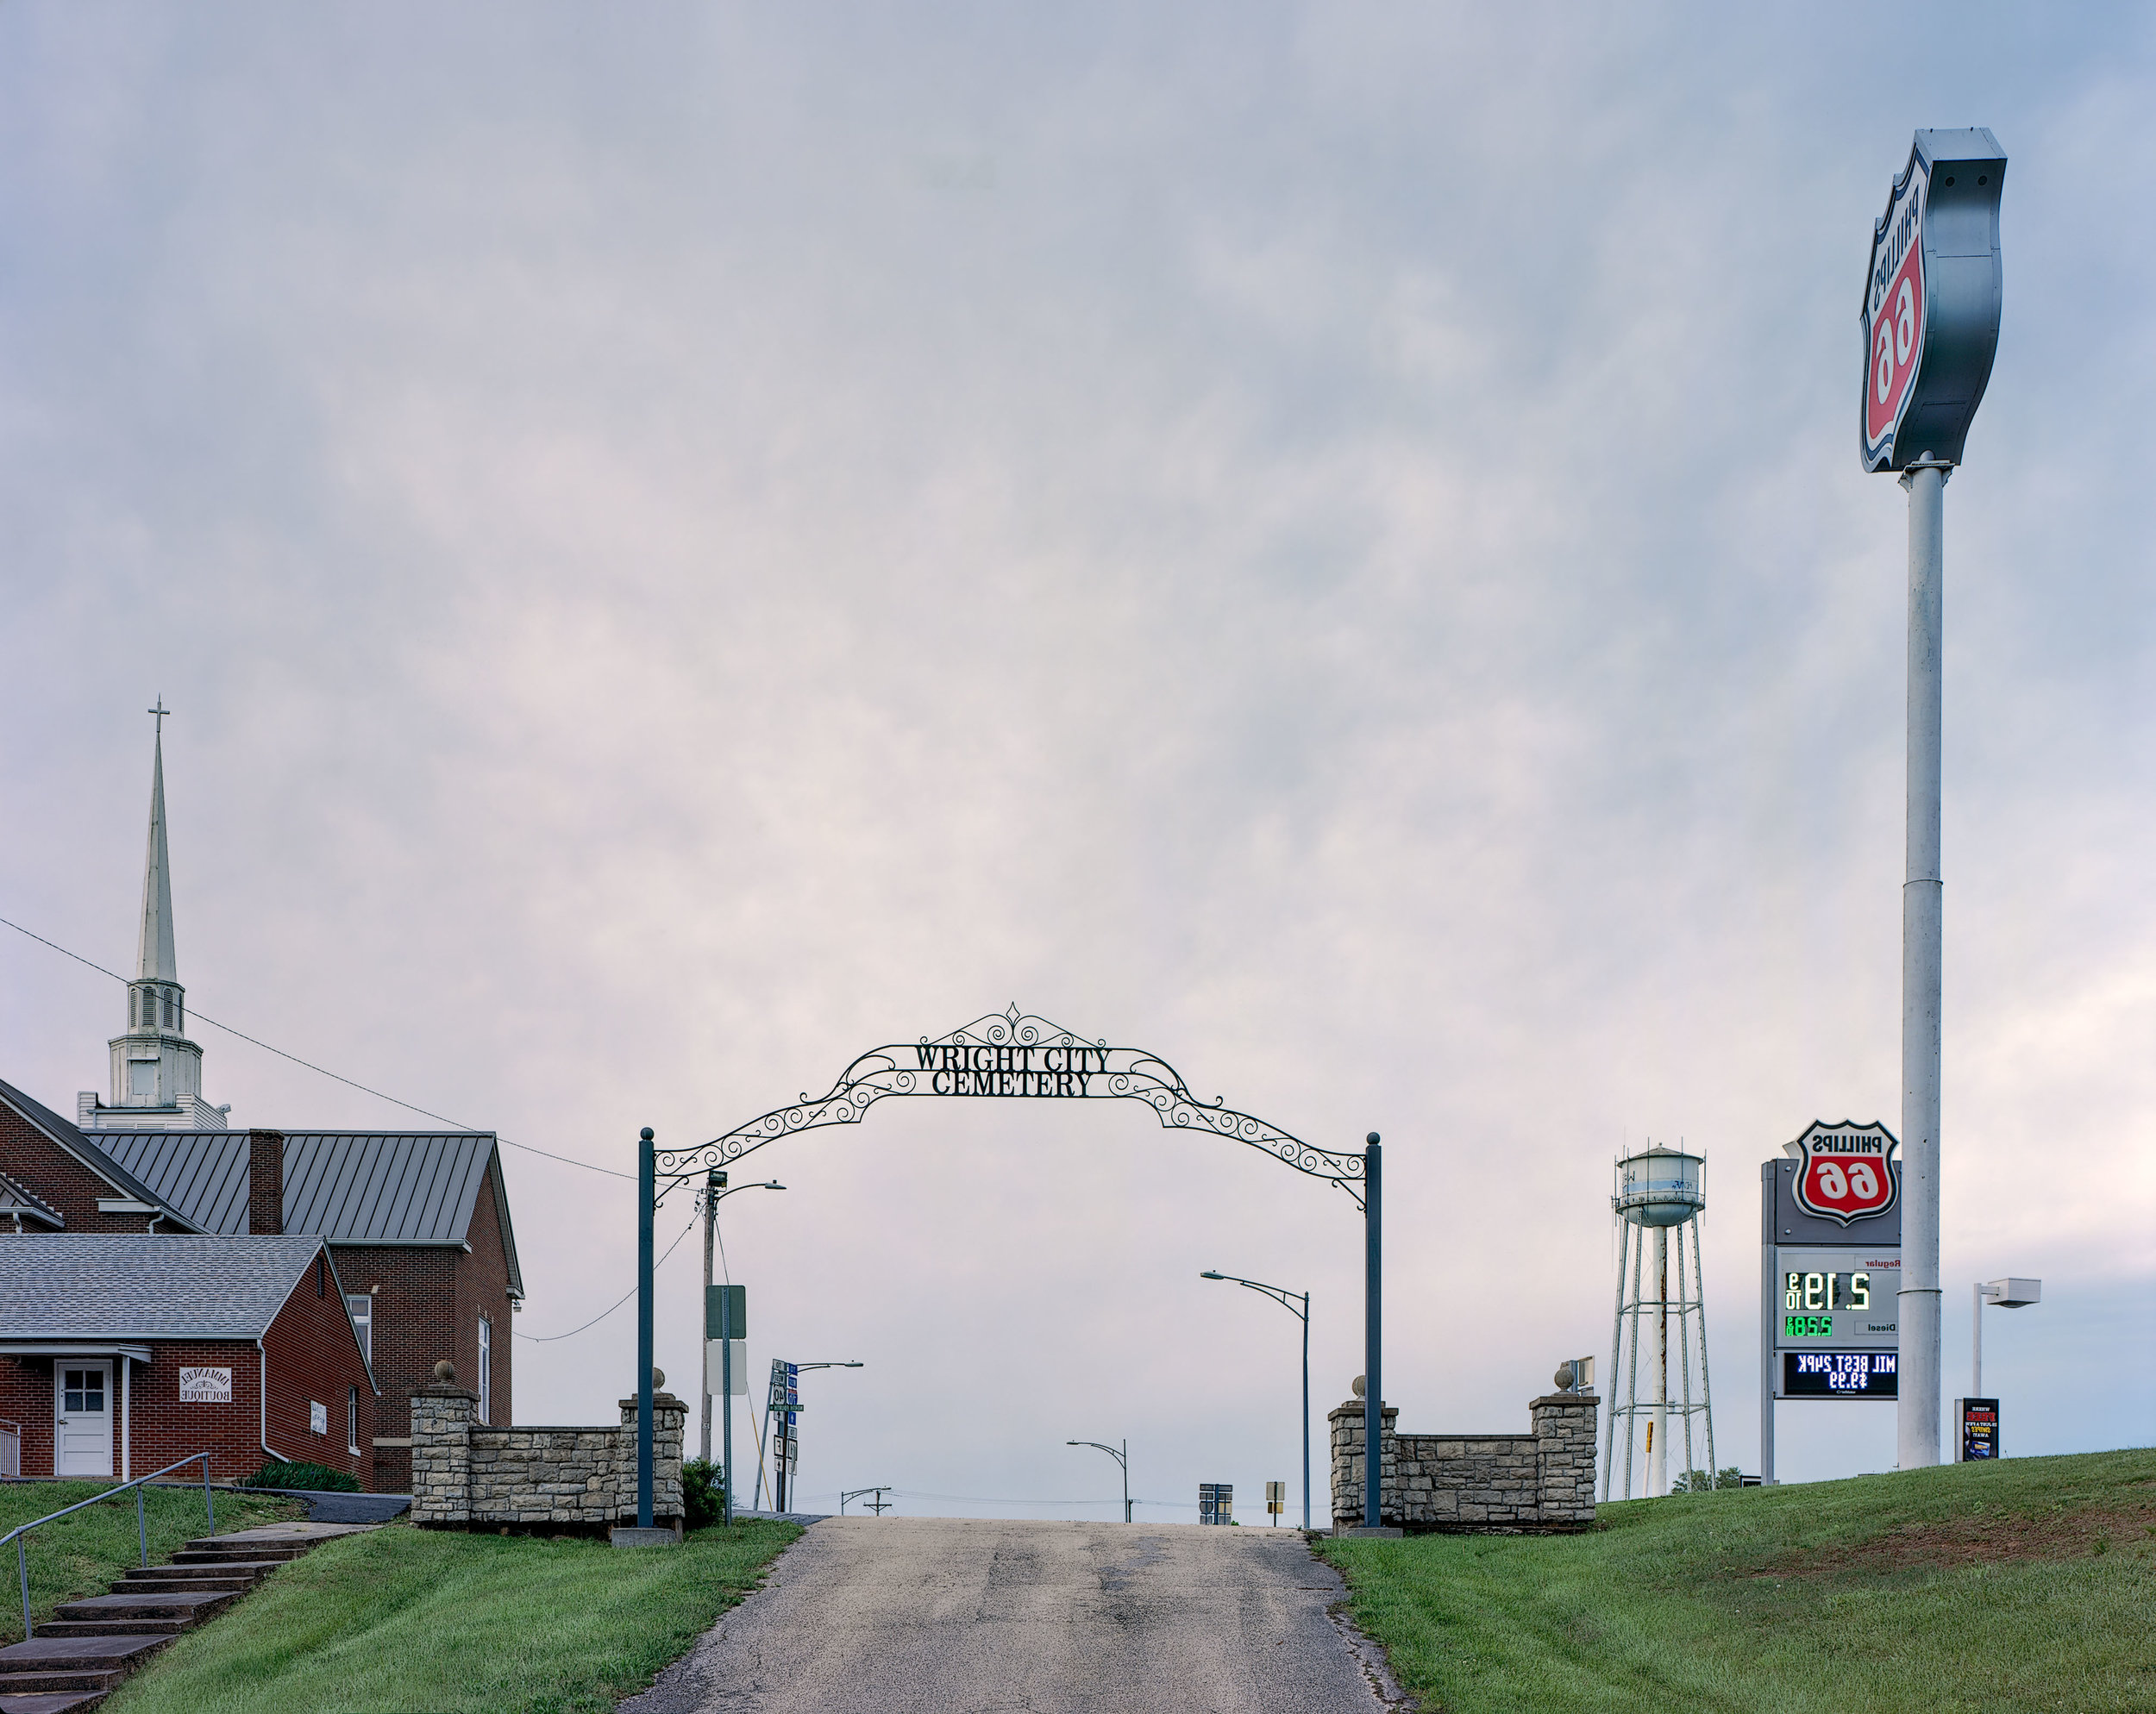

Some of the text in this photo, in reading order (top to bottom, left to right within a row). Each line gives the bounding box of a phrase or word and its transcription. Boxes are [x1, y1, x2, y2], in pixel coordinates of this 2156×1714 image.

[915, 1046, 1112, 1073] WRIGHT CITY
[932, 1070, 1093, 1096] CEMETERY
